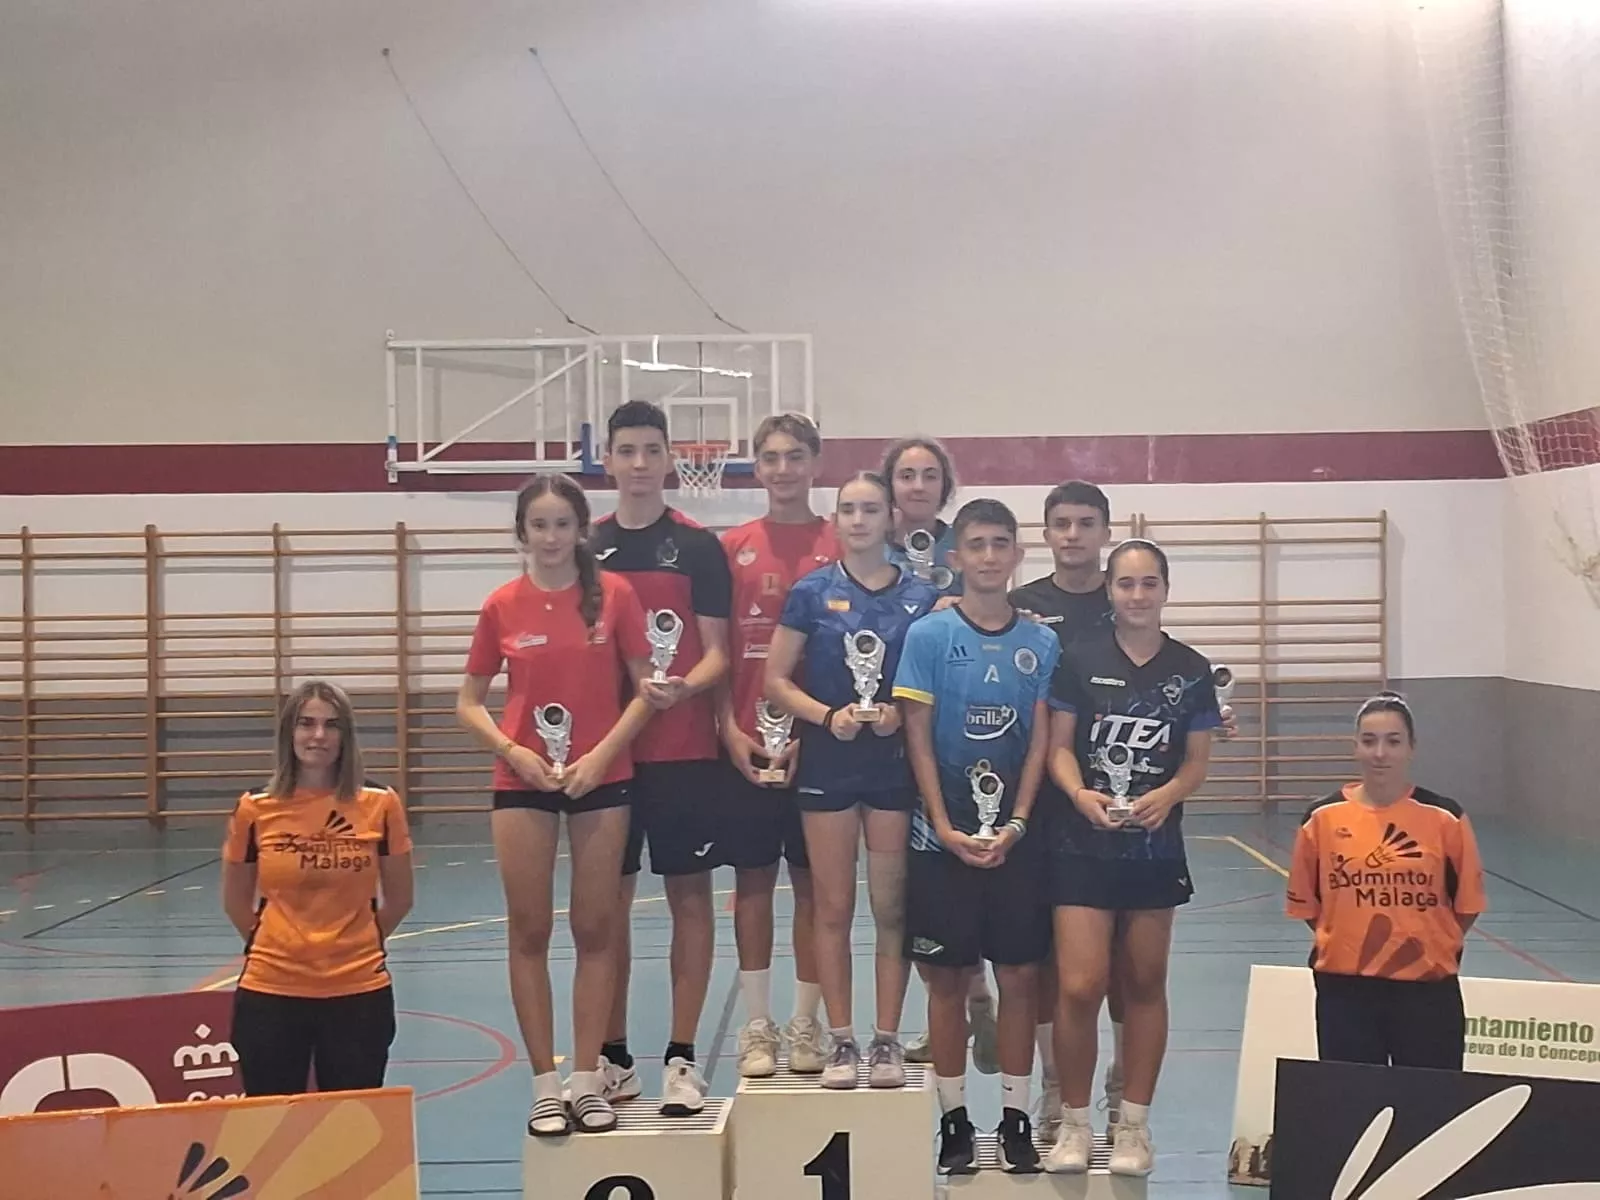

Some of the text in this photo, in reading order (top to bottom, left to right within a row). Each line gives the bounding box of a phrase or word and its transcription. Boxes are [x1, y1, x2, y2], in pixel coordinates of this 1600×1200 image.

[1465, 1042, 1600, 1063] eva de la Concep
[803, 1131, 851, 1200] 1
